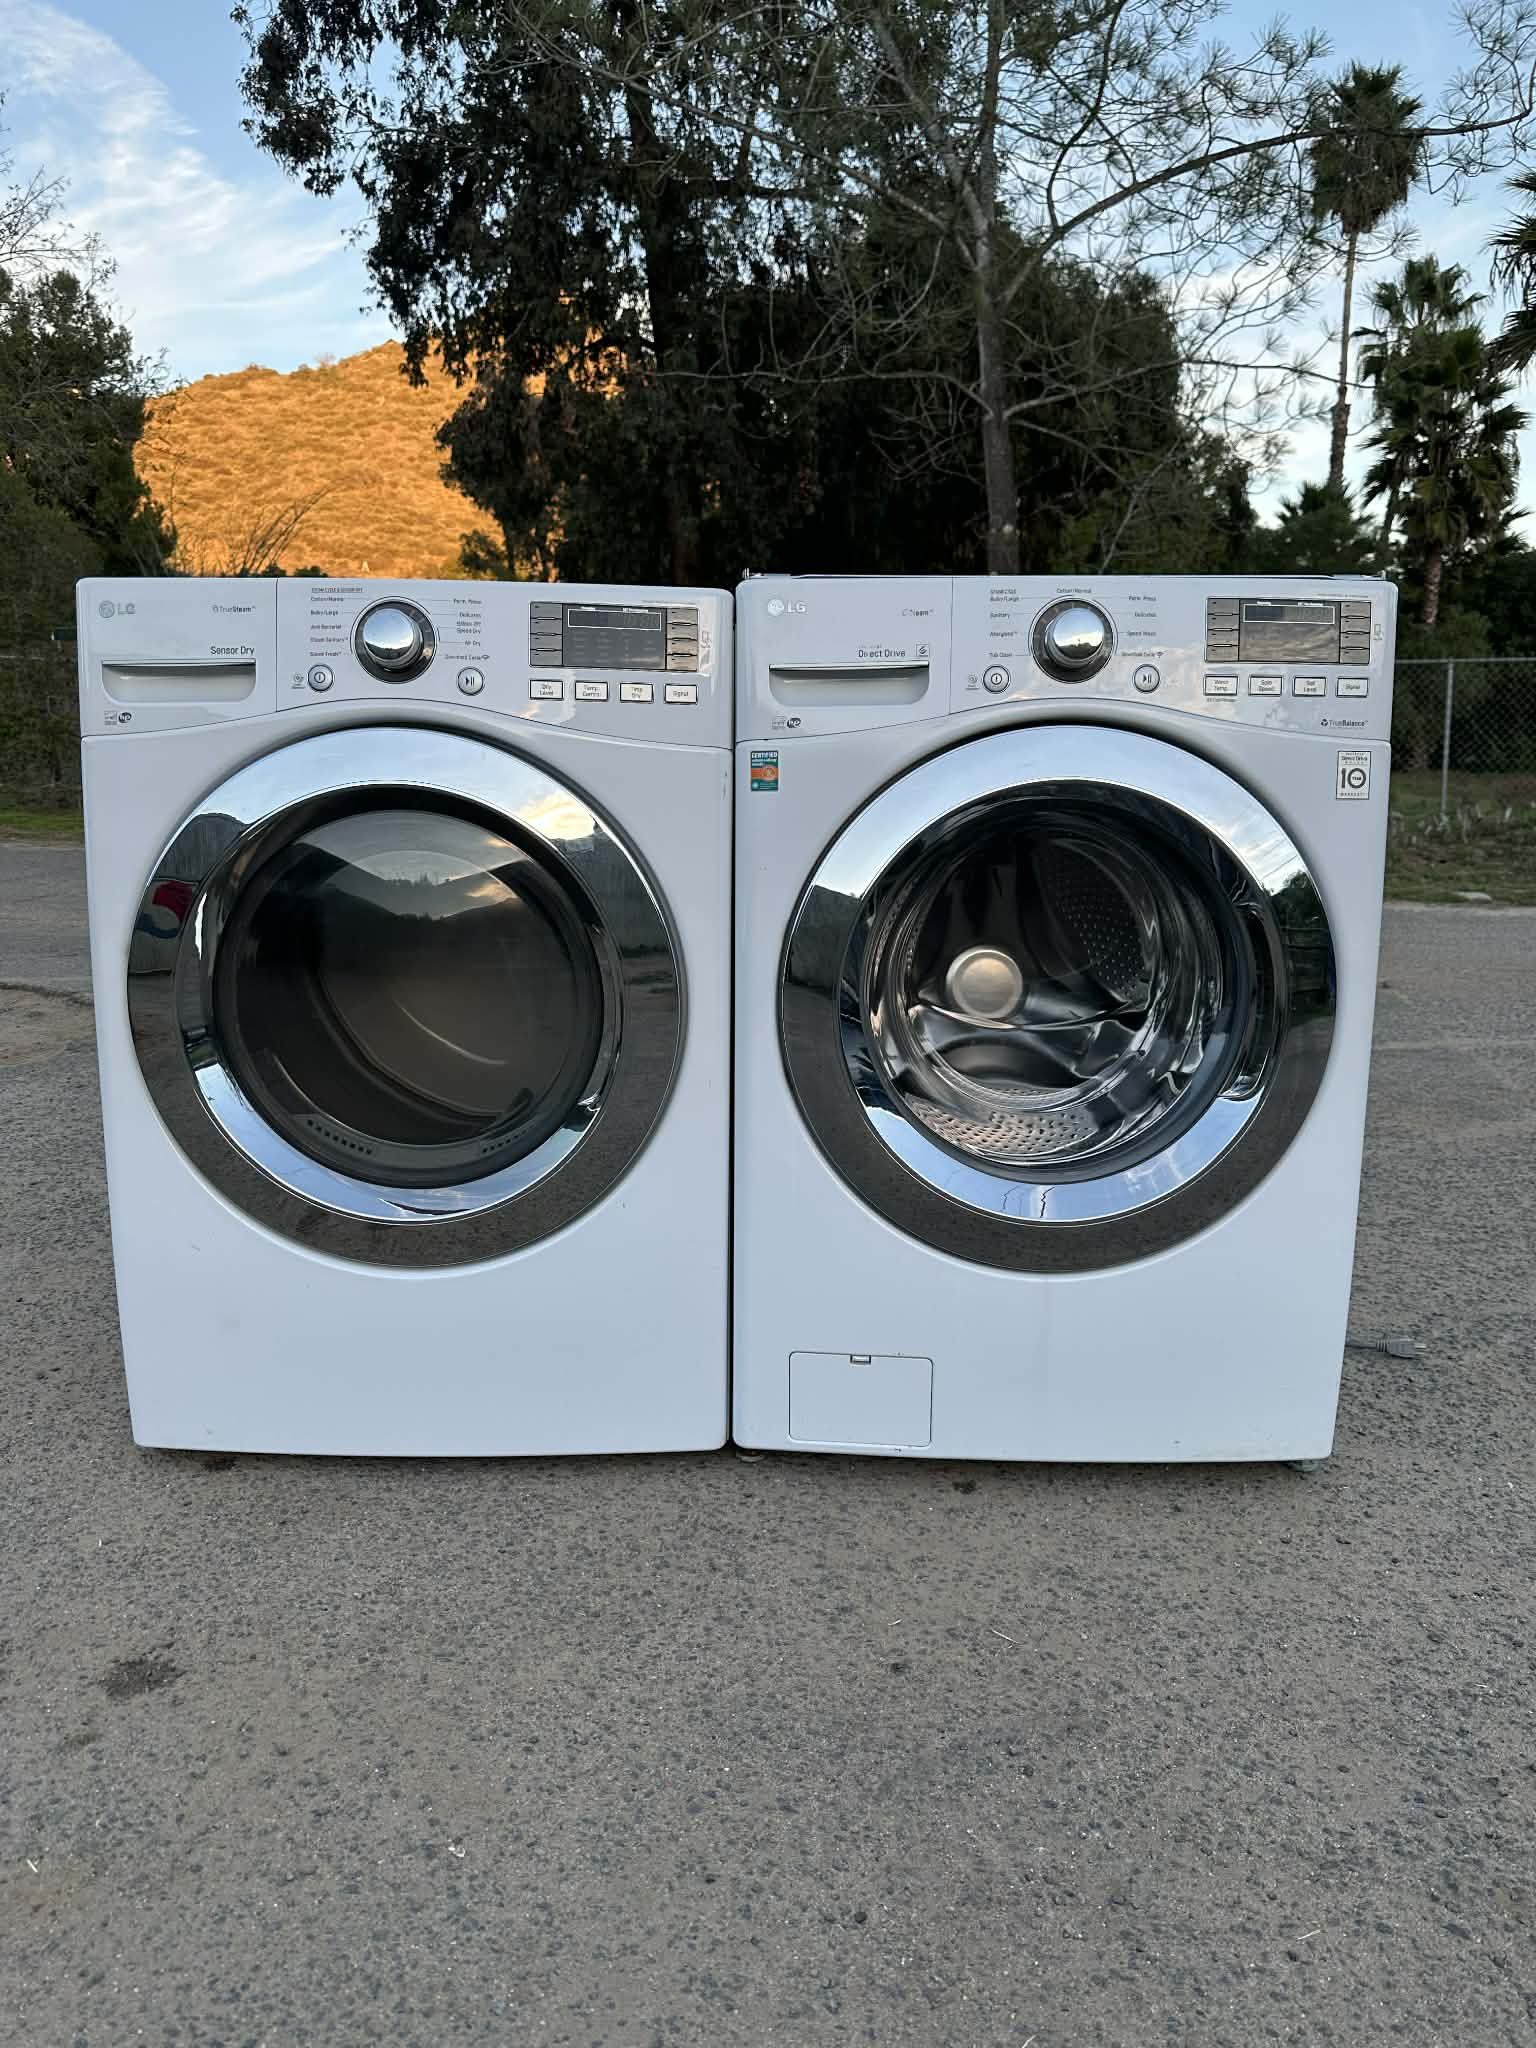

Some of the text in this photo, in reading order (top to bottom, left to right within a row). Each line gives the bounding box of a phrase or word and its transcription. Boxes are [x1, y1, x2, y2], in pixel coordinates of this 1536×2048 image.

[117, 602, 136, 616] LG
[787, 601, 806, 613] LG
[210, 645, 255, 656] Sensor Dry
[884, 649, 906, 658] Drive
[1341, 767, 1367, 789] 10
